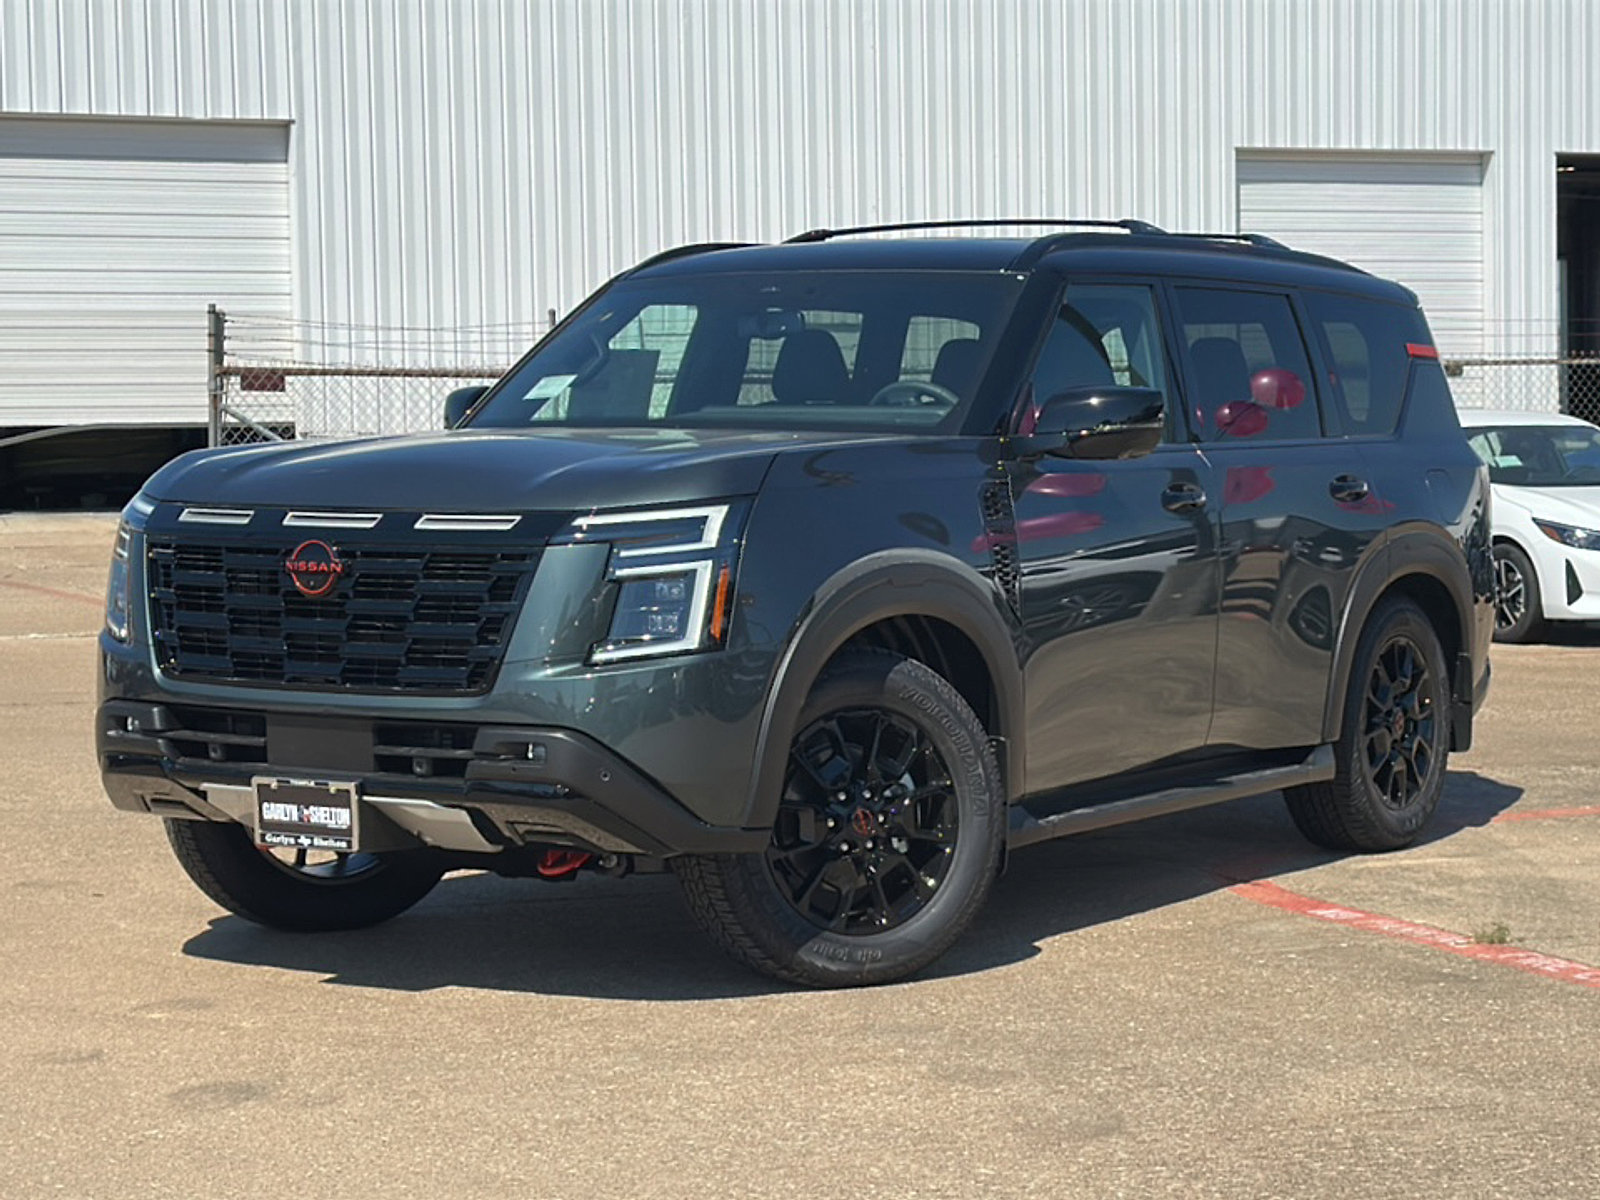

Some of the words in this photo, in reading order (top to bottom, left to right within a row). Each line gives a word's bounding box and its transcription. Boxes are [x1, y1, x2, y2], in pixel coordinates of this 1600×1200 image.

[285, 560, 342, 573] NISSAN
[262, 802, 298, 821] GARLYN
[308, 805, 350, 825] SHELTON
